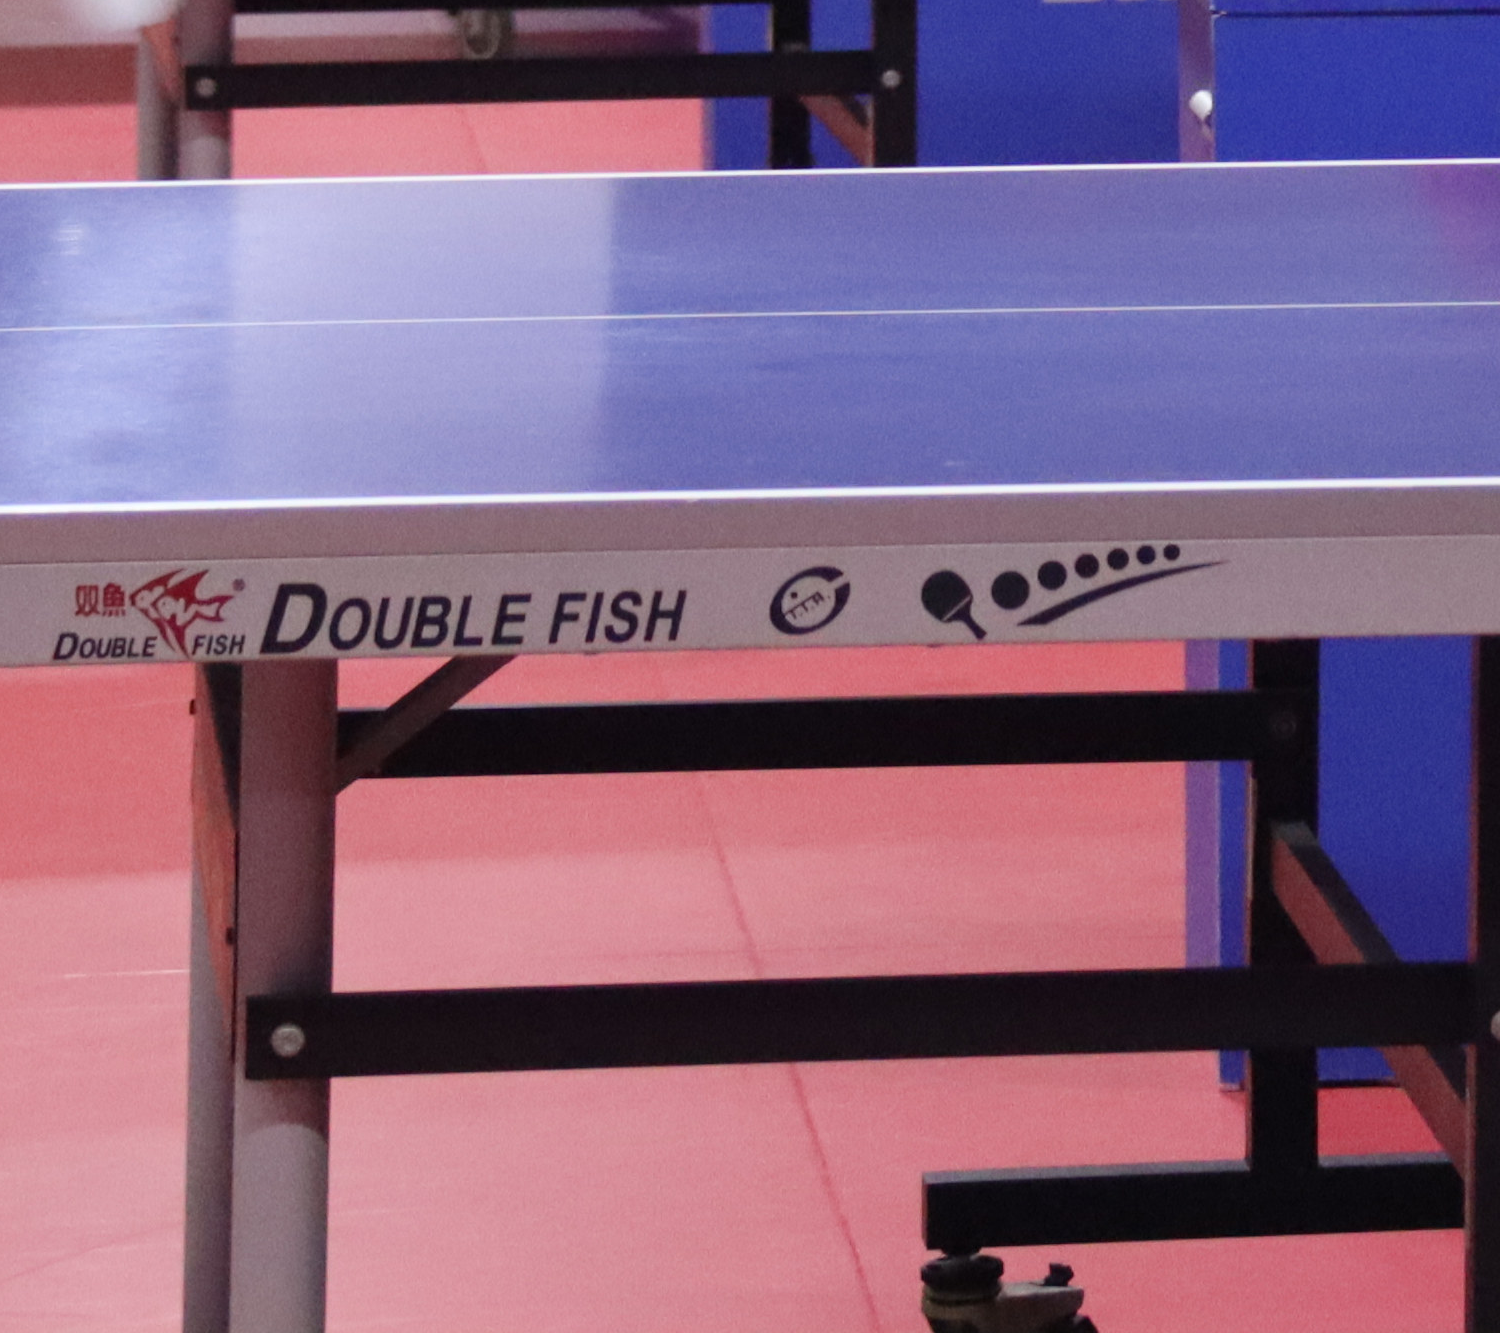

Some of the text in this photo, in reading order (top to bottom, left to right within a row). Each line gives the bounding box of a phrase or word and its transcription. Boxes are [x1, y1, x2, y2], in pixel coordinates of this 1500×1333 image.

[260, 582, 690, 656] DOUBLE FISH
[52, 632, 247, 661] DOUBLE FISH
